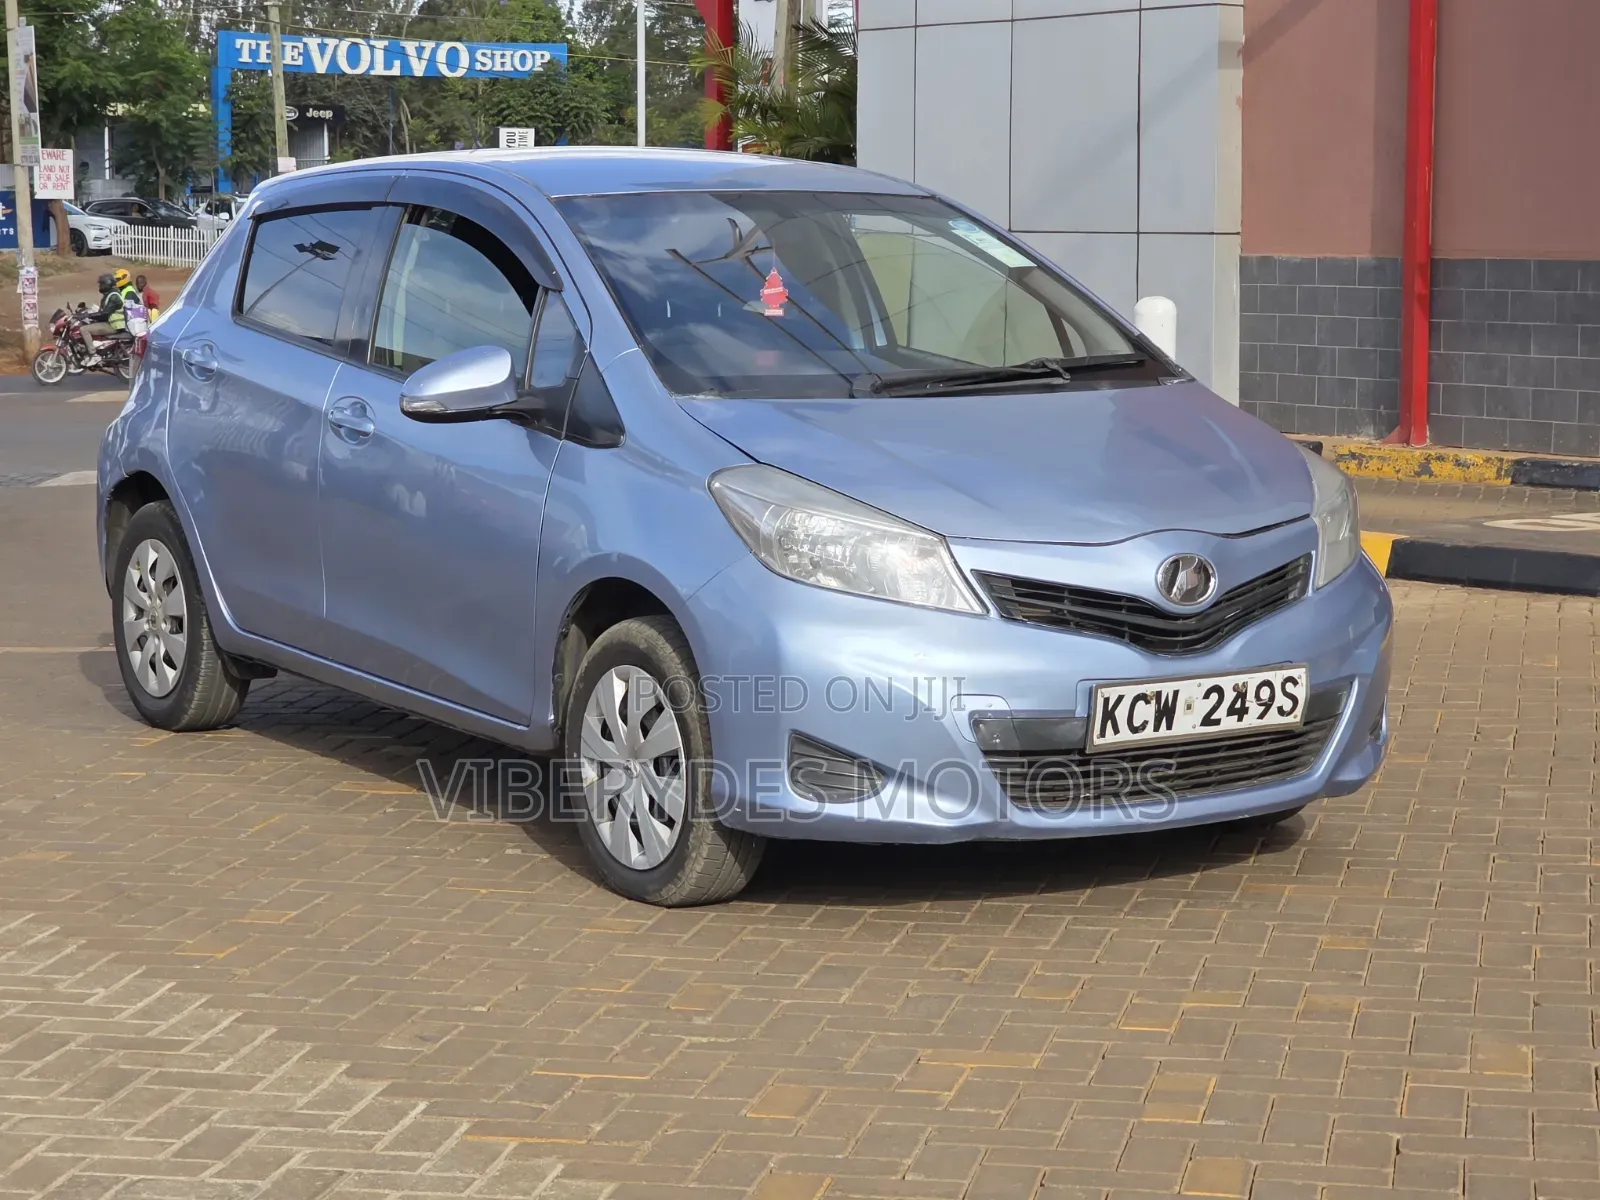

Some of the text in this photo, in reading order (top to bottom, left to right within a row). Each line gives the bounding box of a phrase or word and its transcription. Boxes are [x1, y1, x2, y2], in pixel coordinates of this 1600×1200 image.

[303, 37, 470, 78] VOLVO
[475, 49, 551, 71] SHOP
[306, 108, 333, 120] Jeep
[41, 150, 67, 161] EWARE
[58, 165, 70, 173] NOT
[38, 173, 70, 183] FOR SALE
[39, 182, 68, 191] OR RENT
[0, 227, 14, 236] TS
[1100, 675, 1300, 739] KCW 249S
